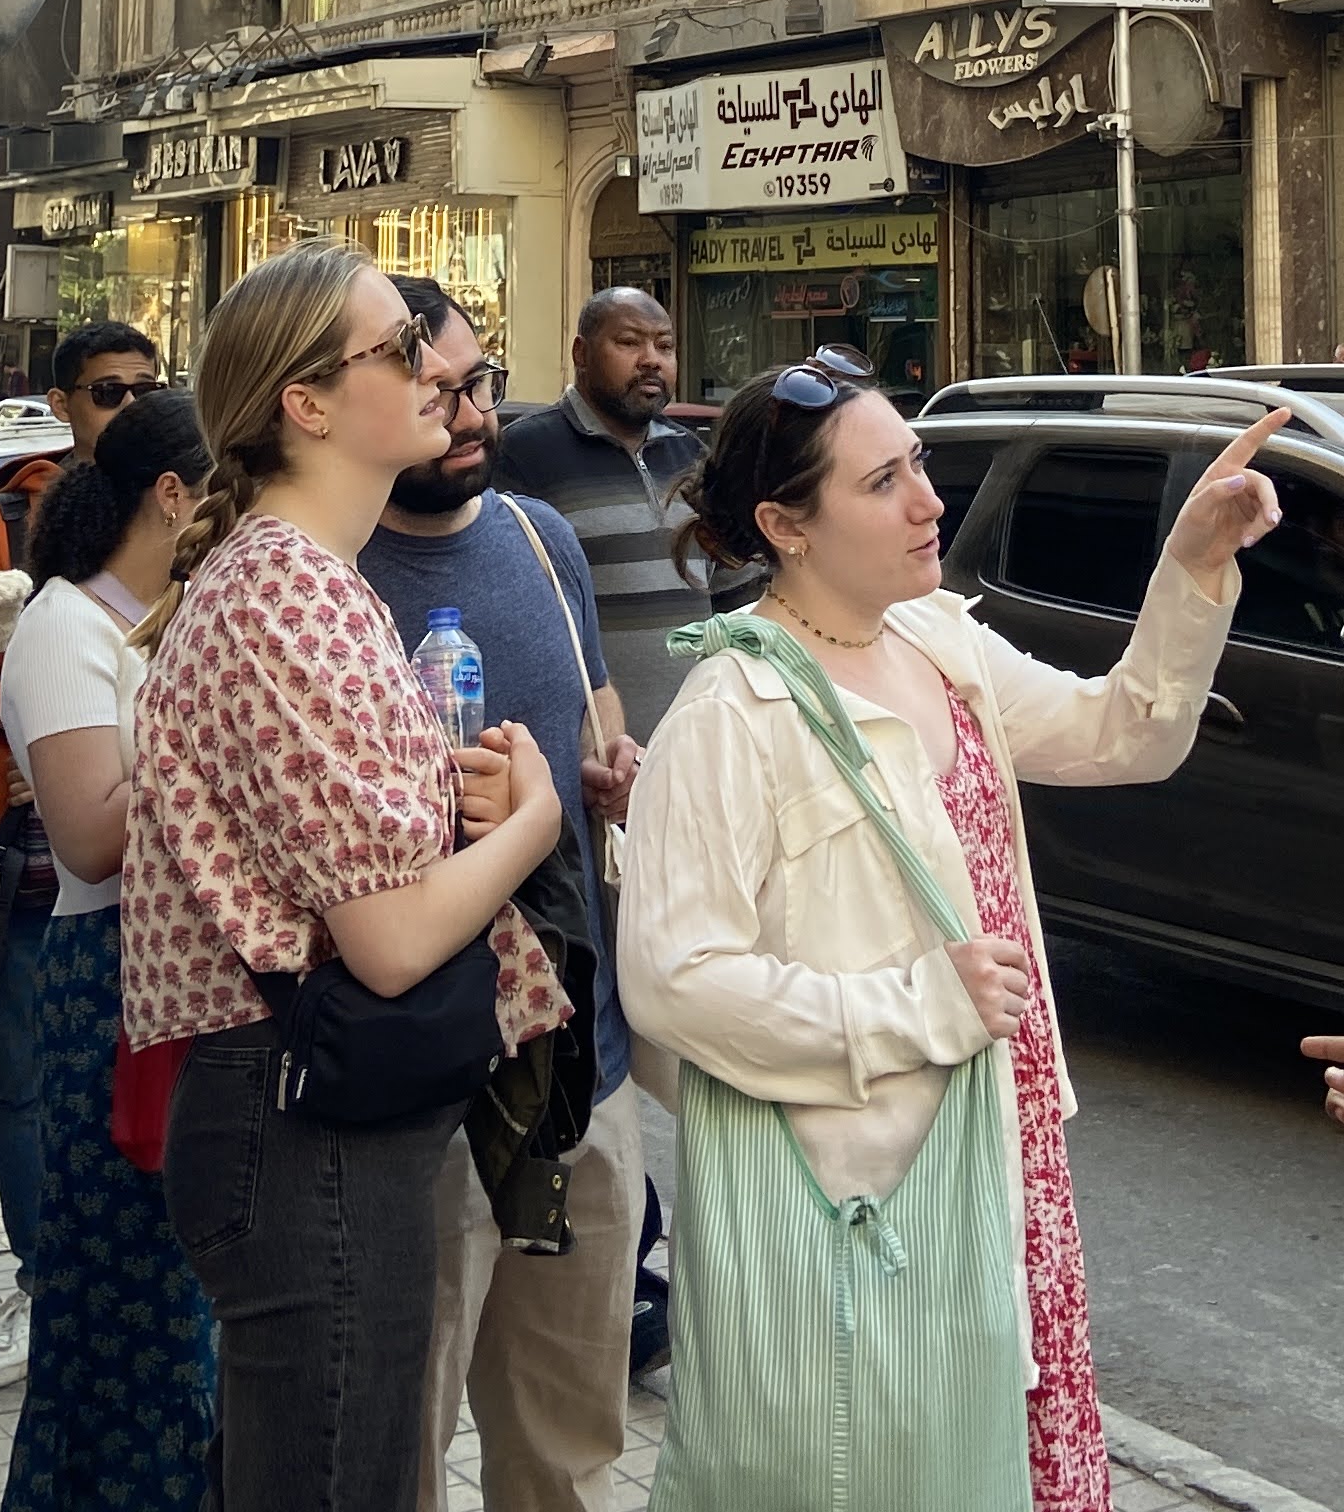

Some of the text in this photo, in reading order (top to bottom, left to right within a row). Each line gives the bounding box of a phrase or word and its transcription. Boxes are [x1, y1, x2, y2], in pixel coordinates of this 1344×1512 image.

[914, 6, 1057, 64] ALLYS
[954, 52, 1039, 80] FLOWERS
[717, 69, 883, 136] الهادى للسياحة
[720, 139, 861, 170] EGYPTAIR
[775, 173, 831, 198] 19359
[689, 236, 785, 265] HADY TRAVEL
[826, 223, 886, 258] للسياحة
